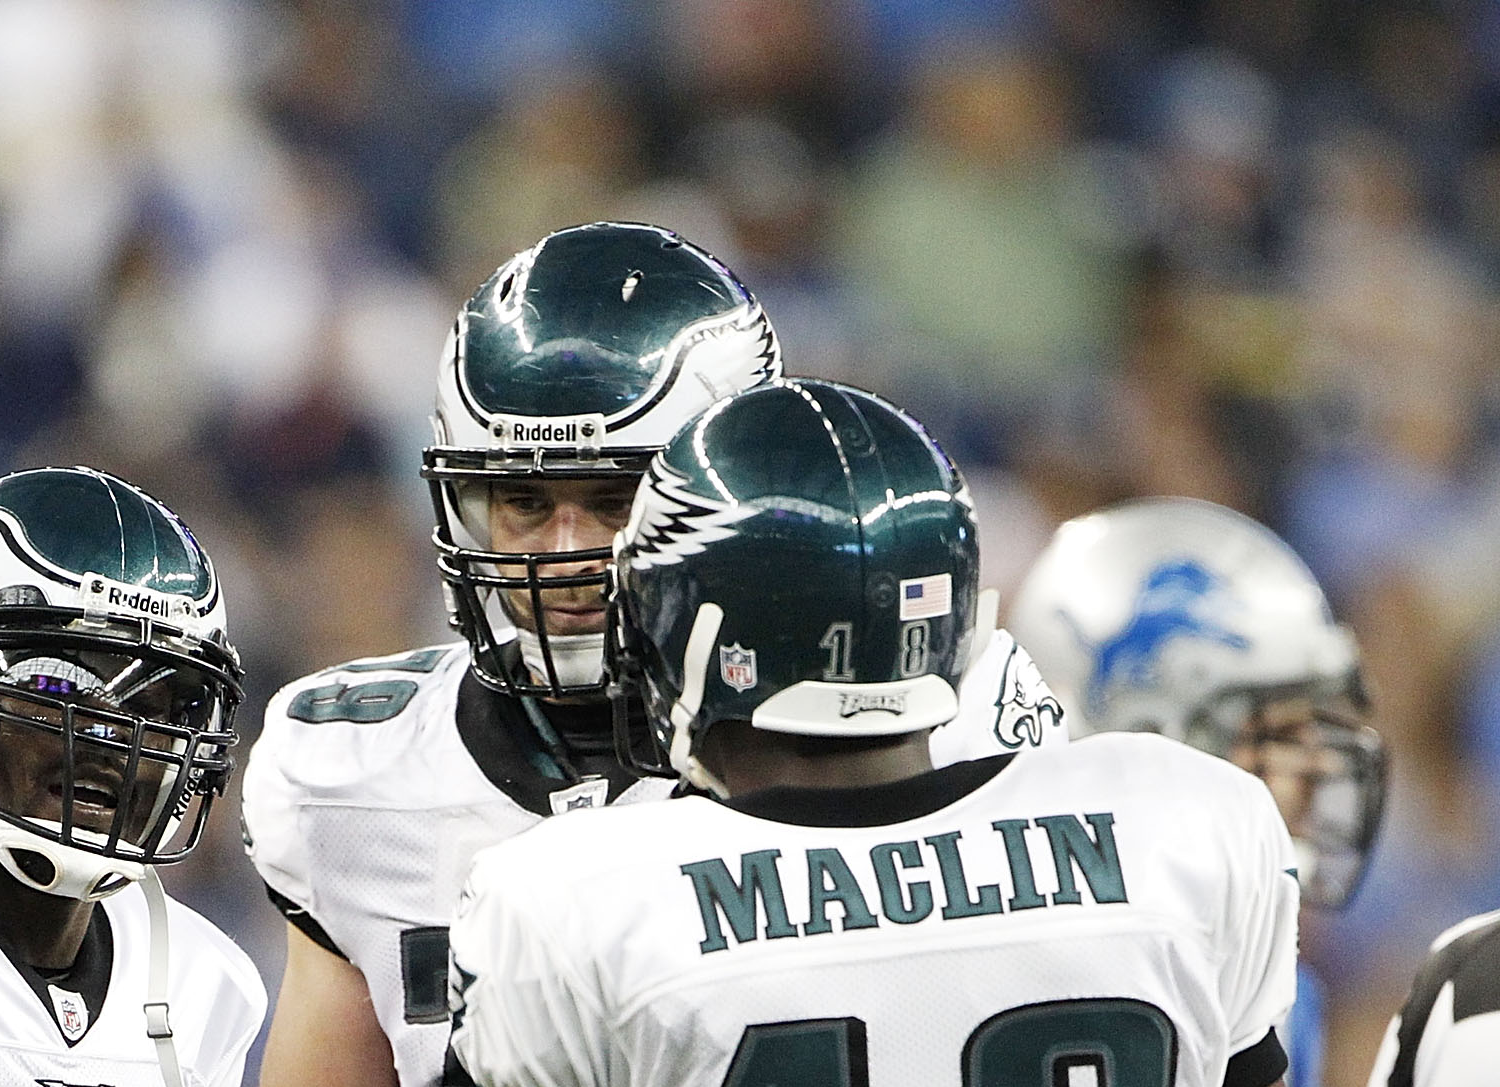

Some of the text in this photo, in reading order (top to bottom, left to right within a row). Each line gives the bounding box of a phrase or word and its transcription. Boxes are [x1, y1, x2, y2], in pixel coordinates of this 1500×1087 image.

[513, 423, 577, 442] Riddell
[108, 586, 169, 618] Riddell
[680, 812, 1130, 955] MACLIN
